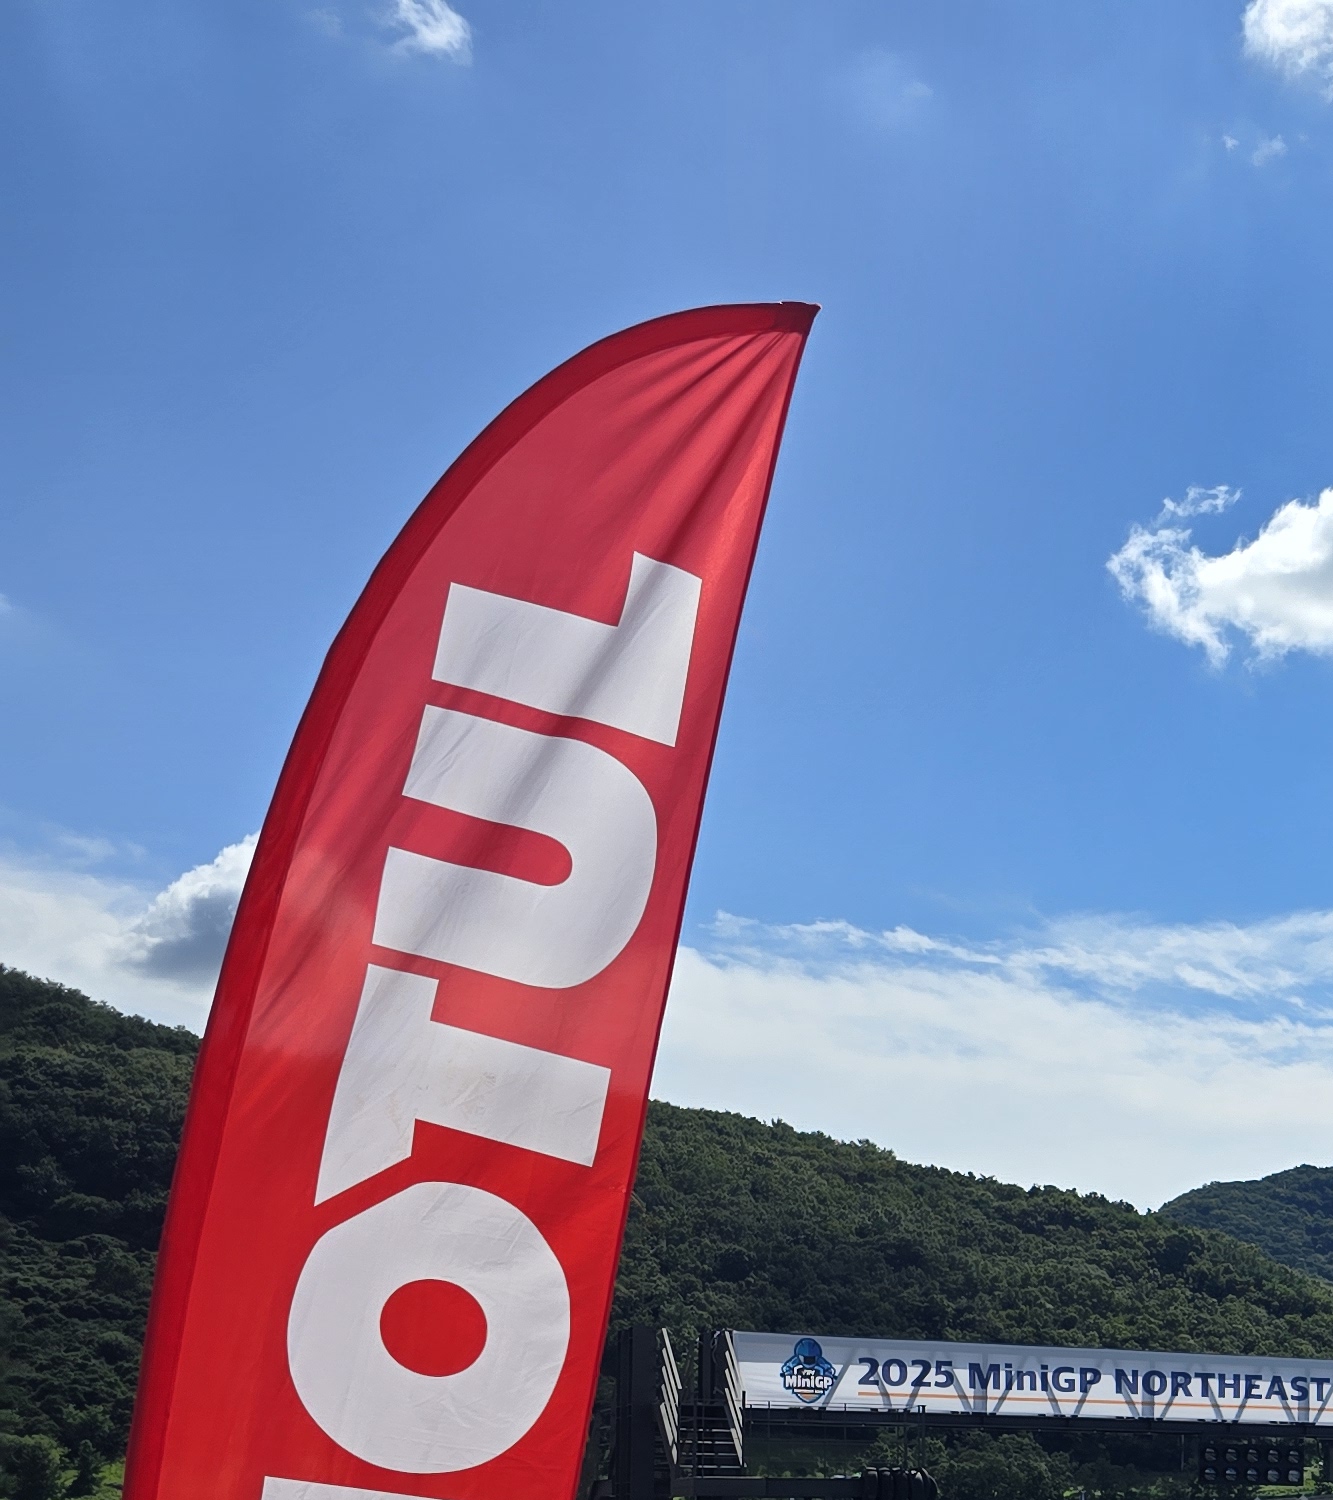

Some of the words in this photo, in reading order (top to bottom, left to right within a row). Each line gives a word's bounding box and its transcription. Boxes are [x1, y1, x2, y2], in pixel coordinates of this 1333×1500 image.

[785, 1374, 833, 1389] MiniGP
[858, 1357, 955, 1388] 2025
[968, 1362, 1102, 1394] MiniGP
[1115, 1368, 1331, 1402] NORTHEAST
